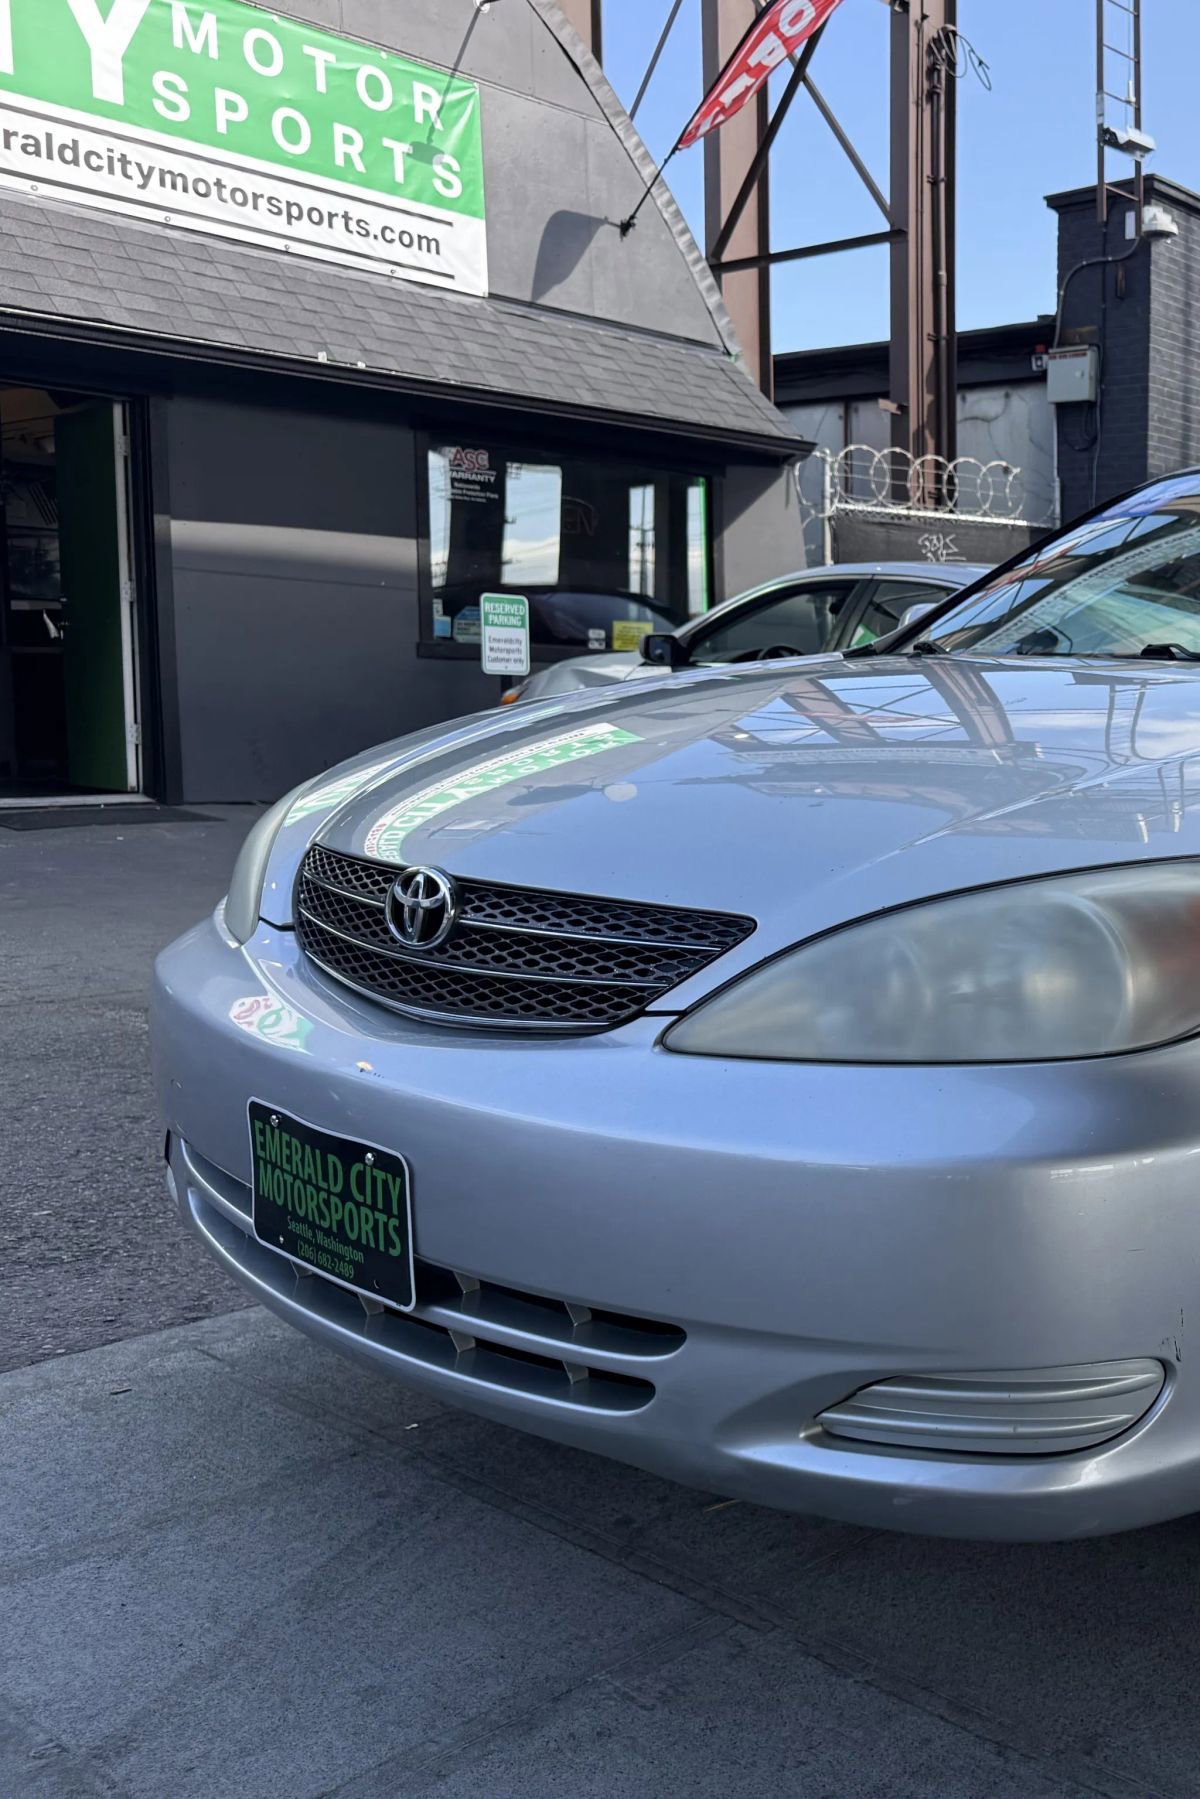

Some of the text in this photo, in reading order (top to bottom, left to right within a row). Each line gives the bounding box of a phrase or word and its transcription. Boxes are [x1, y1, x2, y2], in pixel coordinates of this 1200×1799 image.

[170, 2, 444, 131] MOTOR
[151, 70, 464, 199] SPORTS
[2, 127, 442, 256] raldcitymotorsports.com
[451, 448, 490, 473] ASC
[484, 602, 526, 616] RESERVED
[488, 614, 522, 626] PARKING
[254, 1119, 401, 1216] EMERALD CITY
[259, 1159, 401, 1257] MOTORSPORTS
[287, 1215, 364, 1264] Seattle, Washington
[297, 1240, 354, 1279] (206) 682-2489
